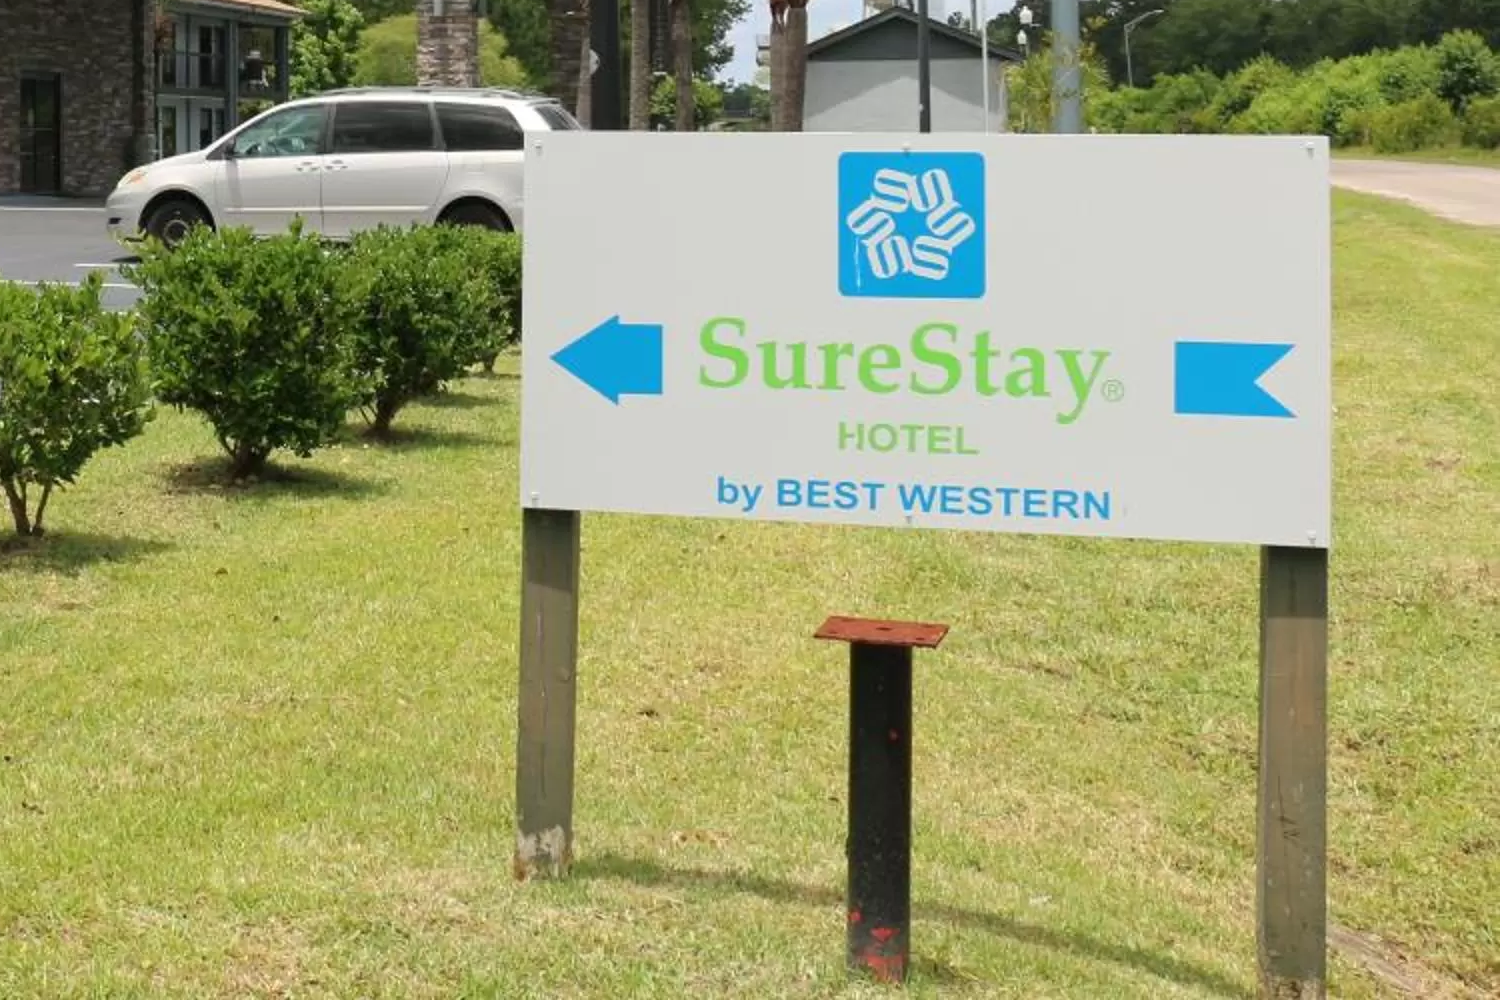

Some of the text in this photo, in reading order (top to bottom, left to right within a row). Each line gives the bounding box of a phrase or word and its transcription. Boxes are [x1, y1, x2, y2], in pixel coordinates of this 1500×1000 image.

[837, 422, 980, 455] HOTEL
[716, 476, 1111, 520] by BEST WESTERN
